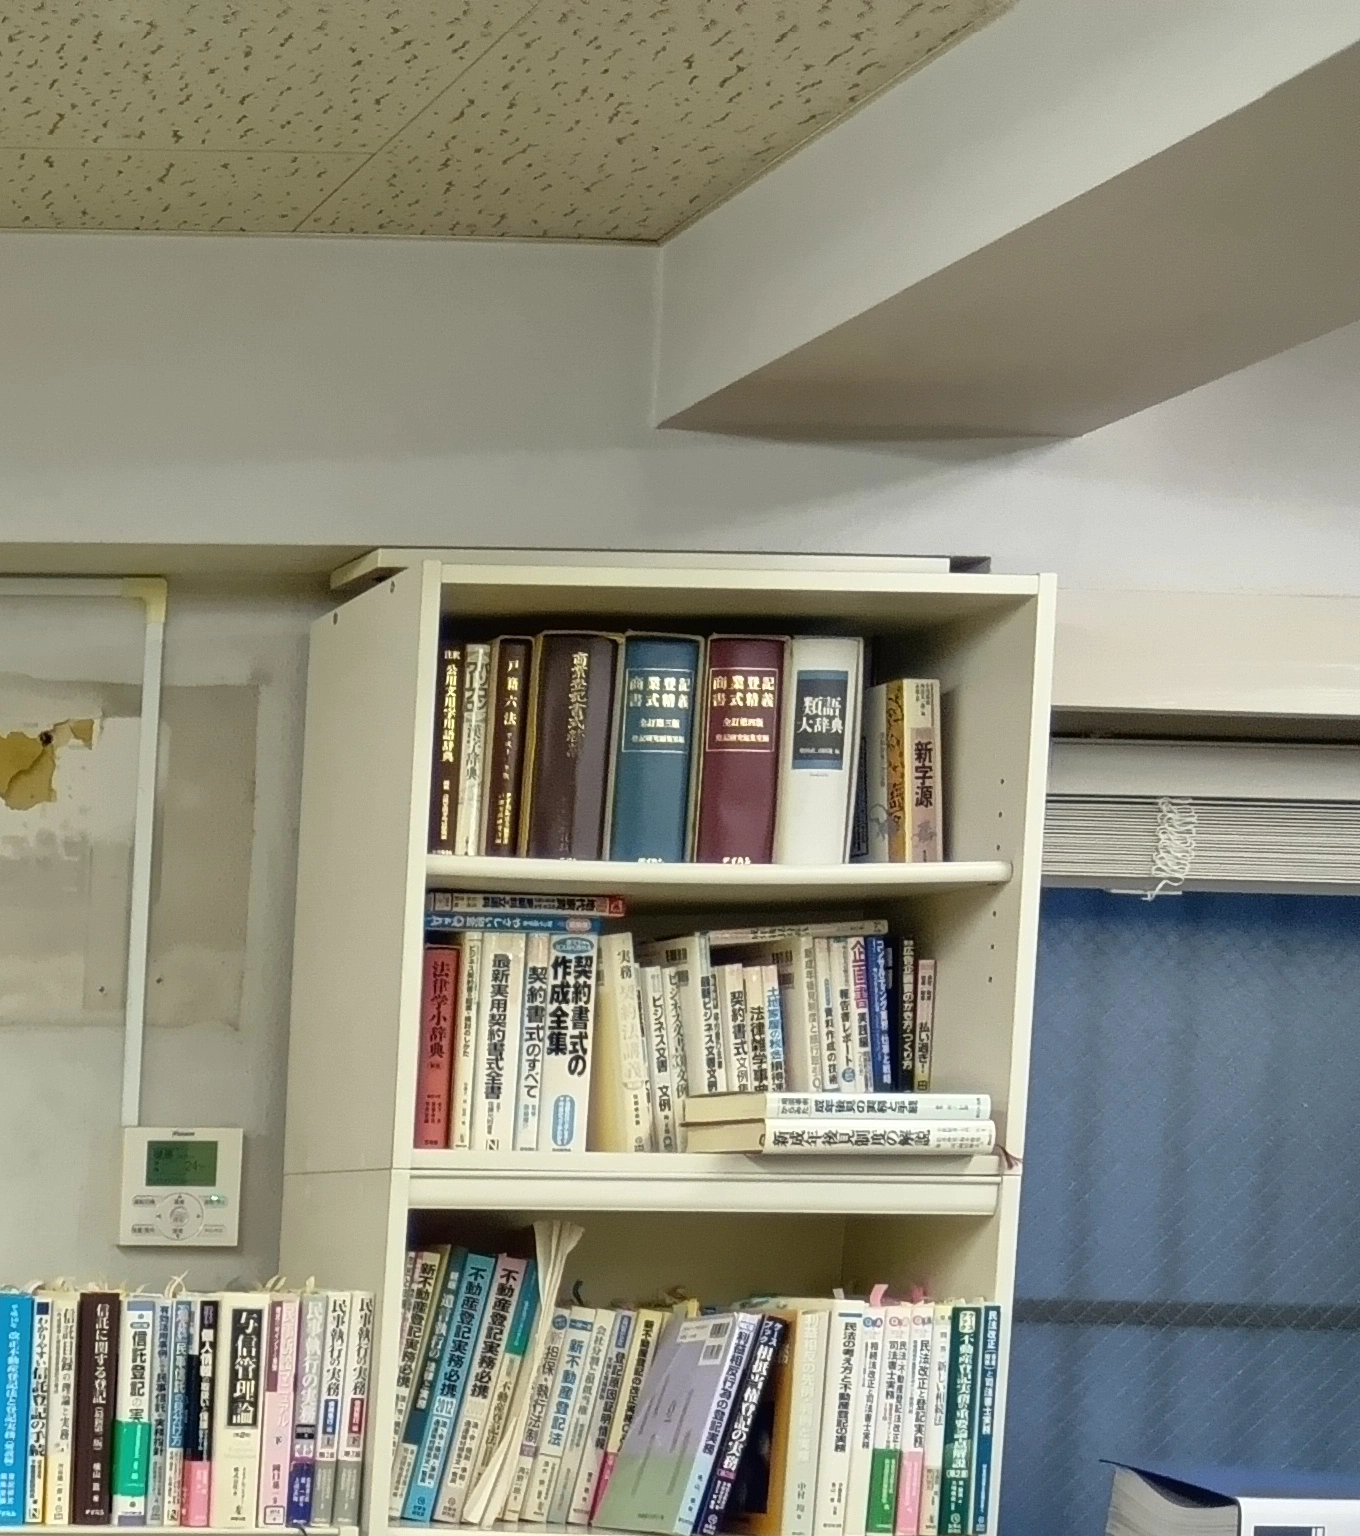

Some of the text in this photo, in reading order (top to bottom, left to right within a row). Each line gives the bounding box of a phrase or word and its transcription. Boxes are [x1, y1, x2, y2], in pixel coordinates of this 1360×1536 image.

[503, 660, 519, 727] 戸籍六法
[629, 675, 692, 694] 商業登記
[712, 675, 776, 694] 商業登記
[712, 692, 774, 709] 書式精義
[796, 717, 843, 734] 大辞典
[802, 697, 842, 718] 類語
[913, 741, 934, 809] 新字源
[430, 961, 451, 1059] 法律学小辞典
[546, 956, 572, 1056] 作成全集
[568, 956, 593, 1077] 契約書式の
[851, 940, 868, 1009] 企画書
[484, 953, 511, 1099] 最新実用契約書式全書
[523, 966, 548, 1098] 契約書式のすべて
[652, 996, 671, 1111] ビジネス文書 文例
[772, 1128, 931, 1147] 新成年後見制度の解説
[60, 1307, 76, 1441] 信託目録の理論と実務
[92, 1304, 109, 1404] 信託に関する登記
[232, 1310, 257, 1426] 与信管理論
[326, 1298, 348, 1397] 民事執行の実務
[351, 1297, 373, 1397] 民事執行の実務
[397, 1263, 437, 1389] 新不動産登記実務必携
[440, 1266, 488, 1399] 不動産登記実務必携
[470, 1267, 520, 1399] 不動産登記実務必携
[885, 1340, 899, 1400] 司法書士実務
[547, 1338, 584, 1448] 新不動産登記法
[595, 1351, 626, 1450] 登記原因証明情報
[834, 1322, 858, 1453] 民法の考え方と不動産登記の実務
[914, 1340, 931, 1448] 民法改正と登記実務
[84, 1508, 105, 1516] テイハン
